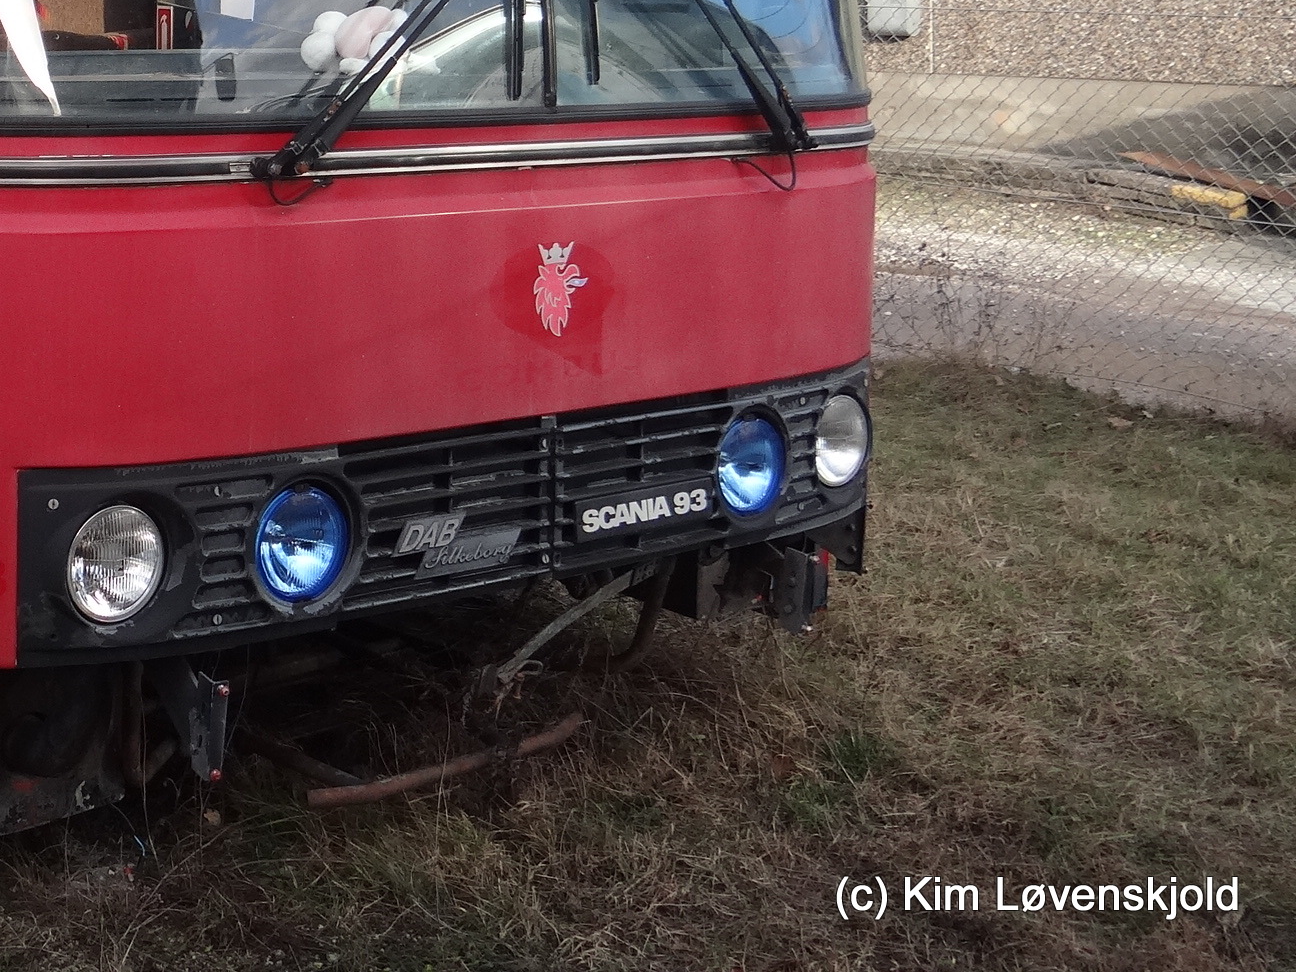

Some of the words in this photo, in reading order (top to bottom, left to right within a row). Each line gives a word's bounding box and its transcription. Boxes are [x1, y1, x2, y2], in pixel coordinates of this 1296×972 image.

[582, 496, 670, 533] SCANIA
[673, 488, 707, 516] 93
[402, 518, 460, 554] DAB
[423, 541, 516, 571] Silkeborg
